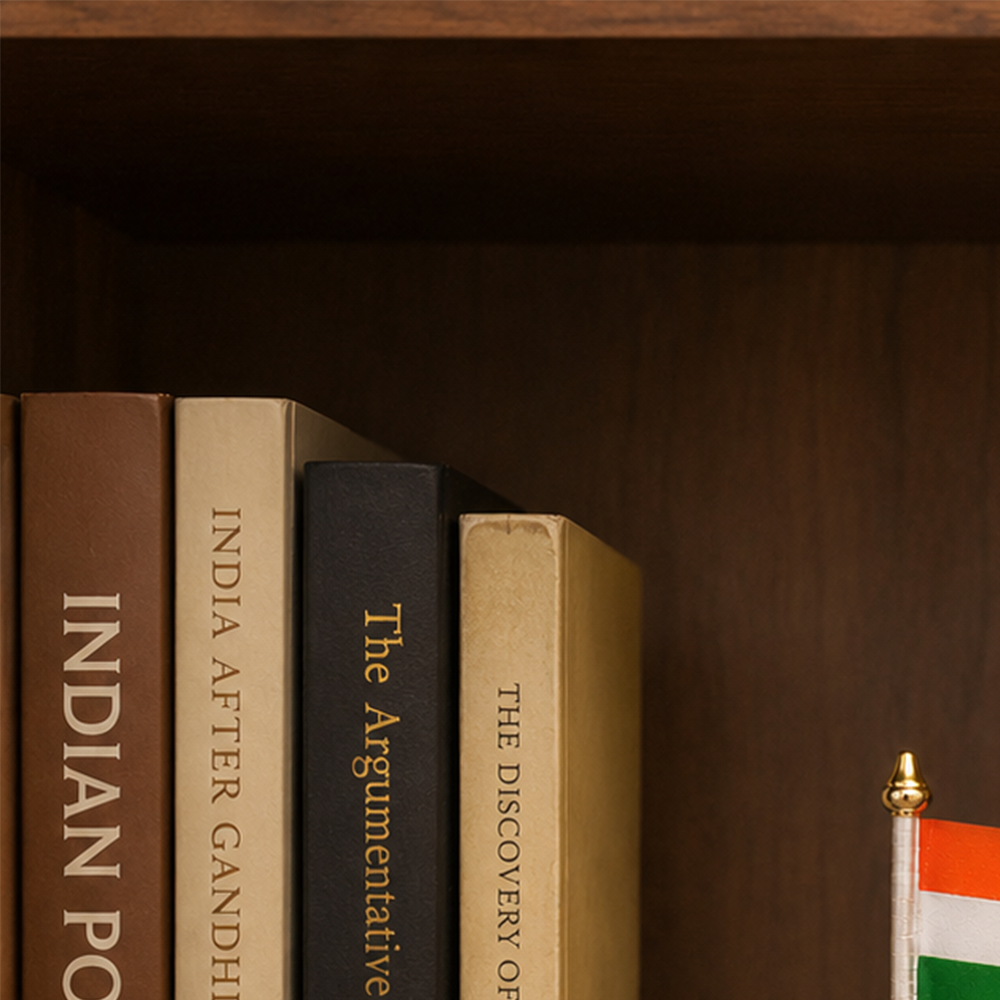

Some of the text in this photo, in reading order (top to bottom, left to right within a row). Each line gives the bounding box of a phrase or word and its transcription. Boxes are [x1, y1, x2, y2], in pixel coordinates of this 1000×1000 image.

[211, 507, 242, 640] INDIA
[364, 602, 404, 684] The
[62, 592, 121, 879] INDIAN
[211, 656, 241, 805] AFTER
[497, 682, 521, 750] THE
[351, 701, 401, 997] Argumentative
[496, 763, 521, 950] DISCOVERY
